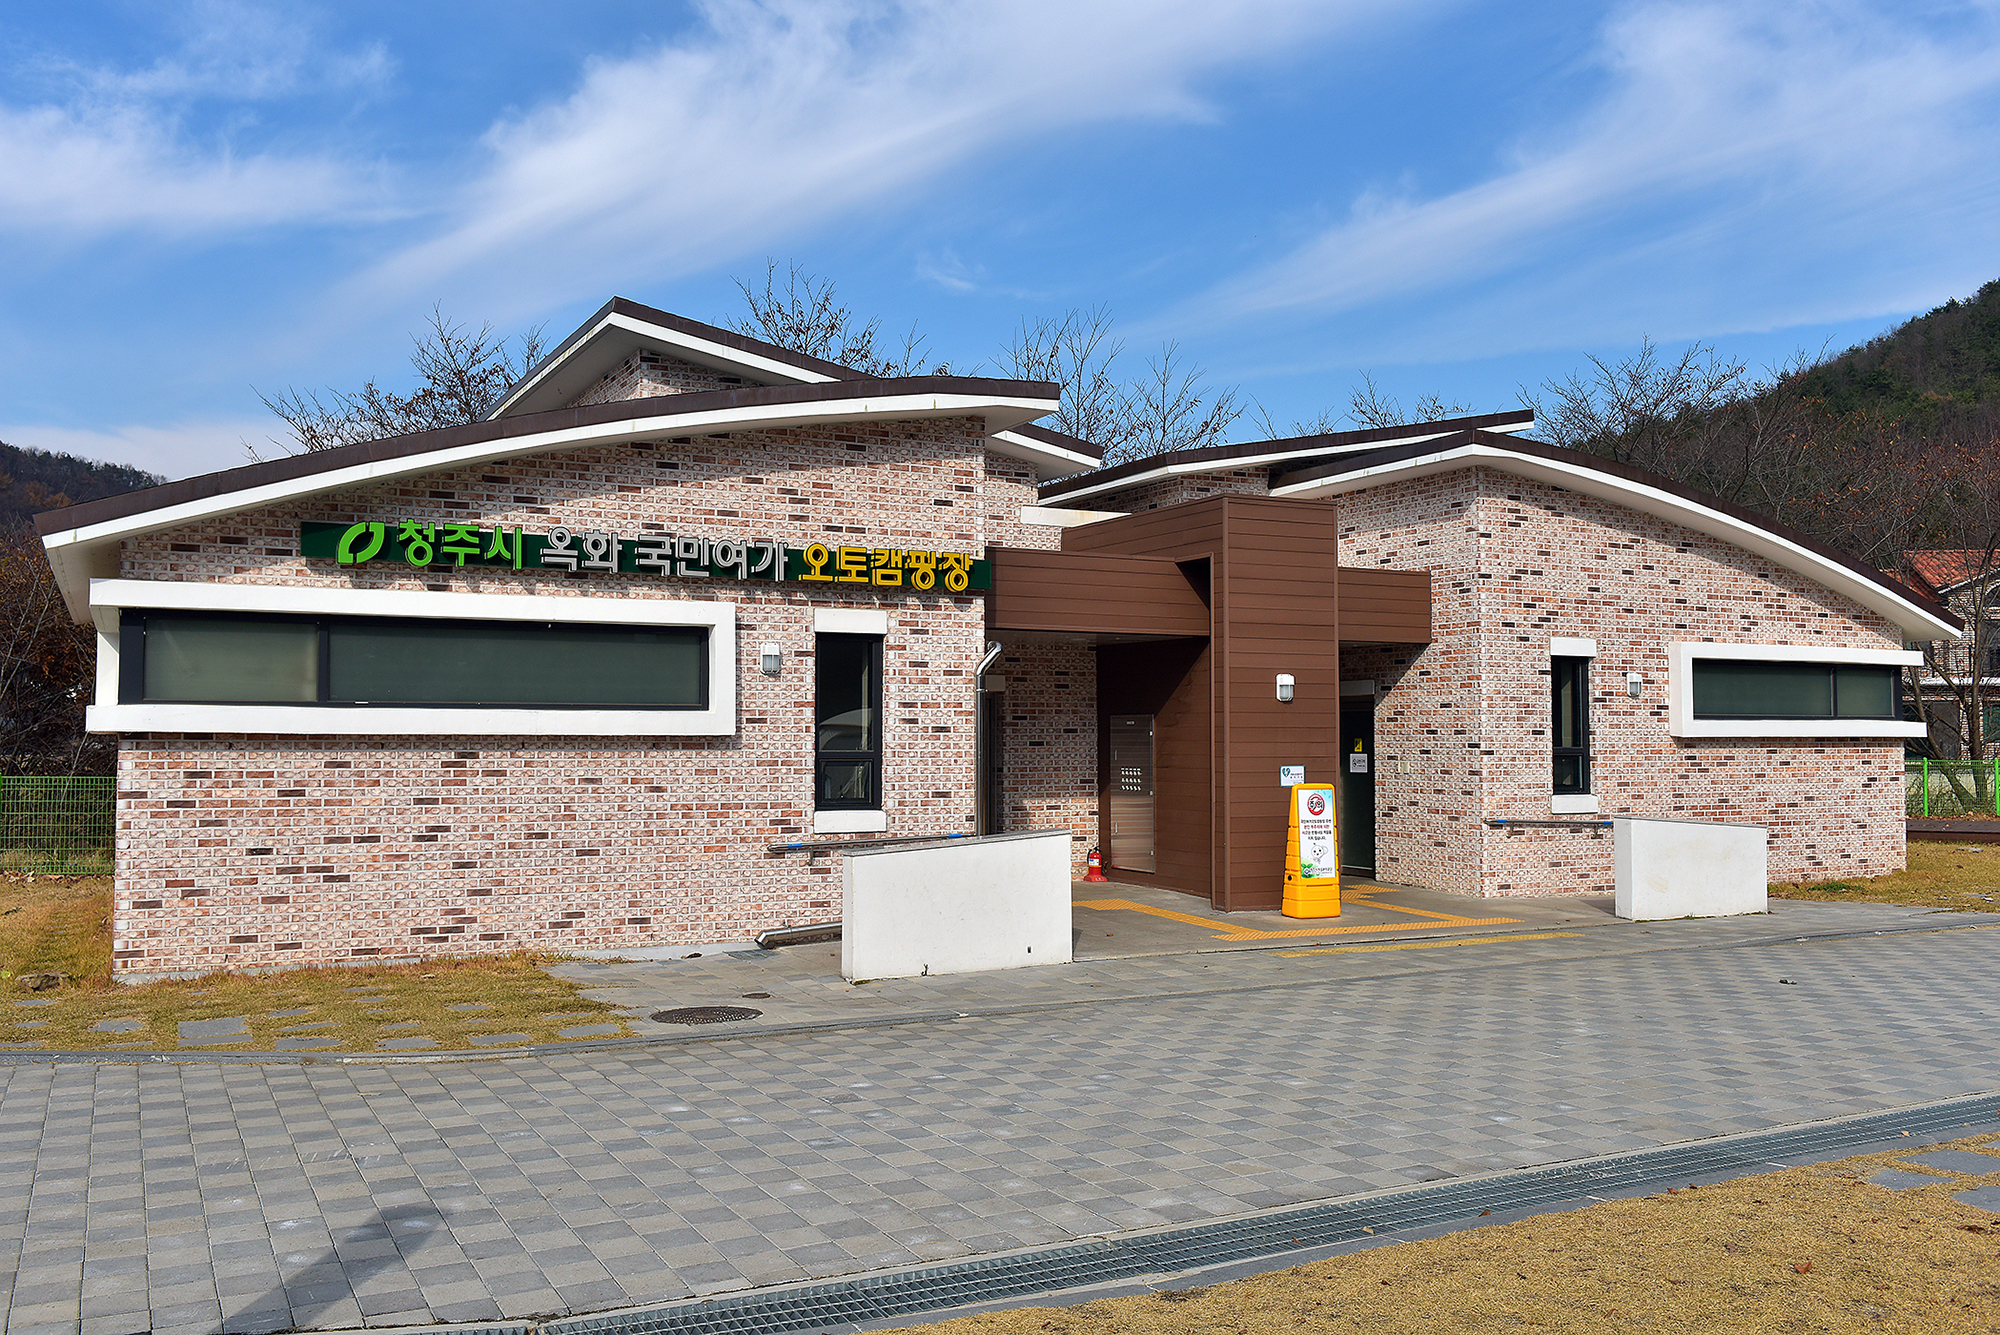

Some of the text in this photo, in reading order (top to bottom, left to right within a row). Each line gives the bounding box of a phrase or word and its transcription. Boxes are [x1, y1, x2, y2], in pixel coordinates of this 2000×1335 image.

[397, 519, 973, 592] 청주시 옥화 국민여가 오토캠핑장
